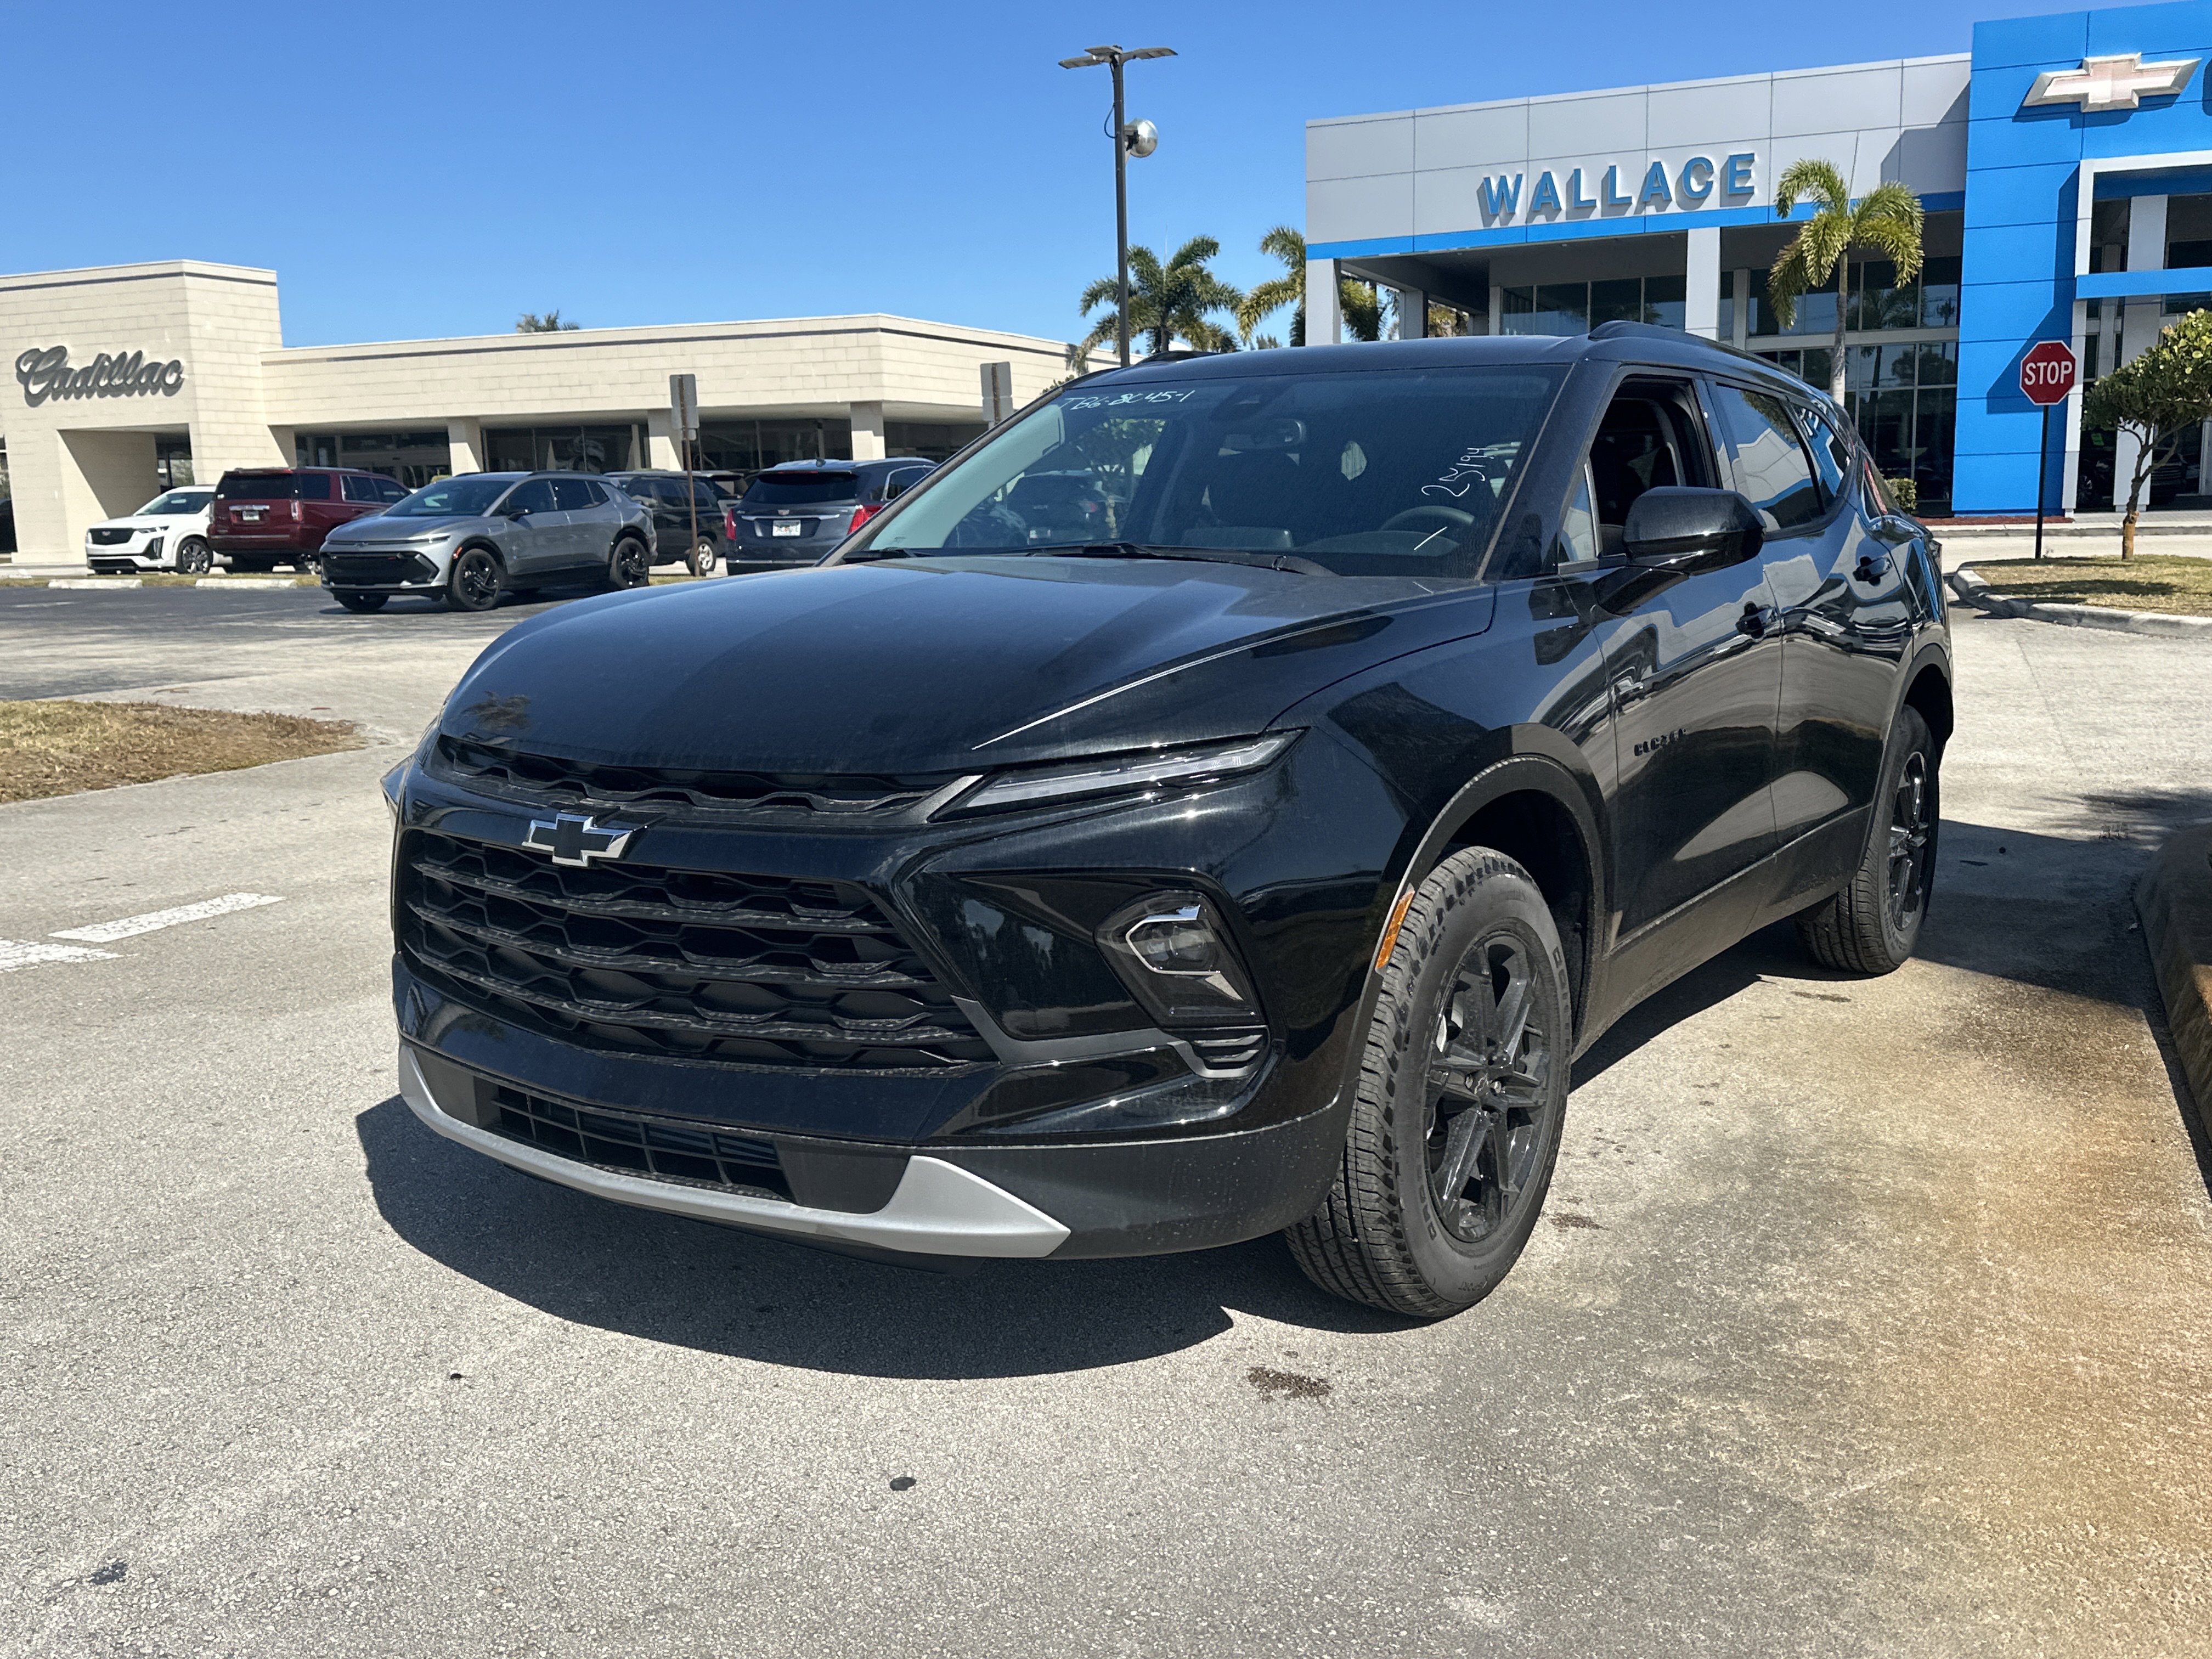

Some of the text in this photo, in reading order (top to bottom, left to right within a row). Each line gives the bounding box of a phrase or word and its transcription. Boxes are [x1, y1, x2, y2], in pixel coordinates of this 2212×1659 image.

[1483, 152, 1756, 215] WALLACE
[15, 345, 184, 400] Cadillac
[2024, 360, 2073, 385] STOP
